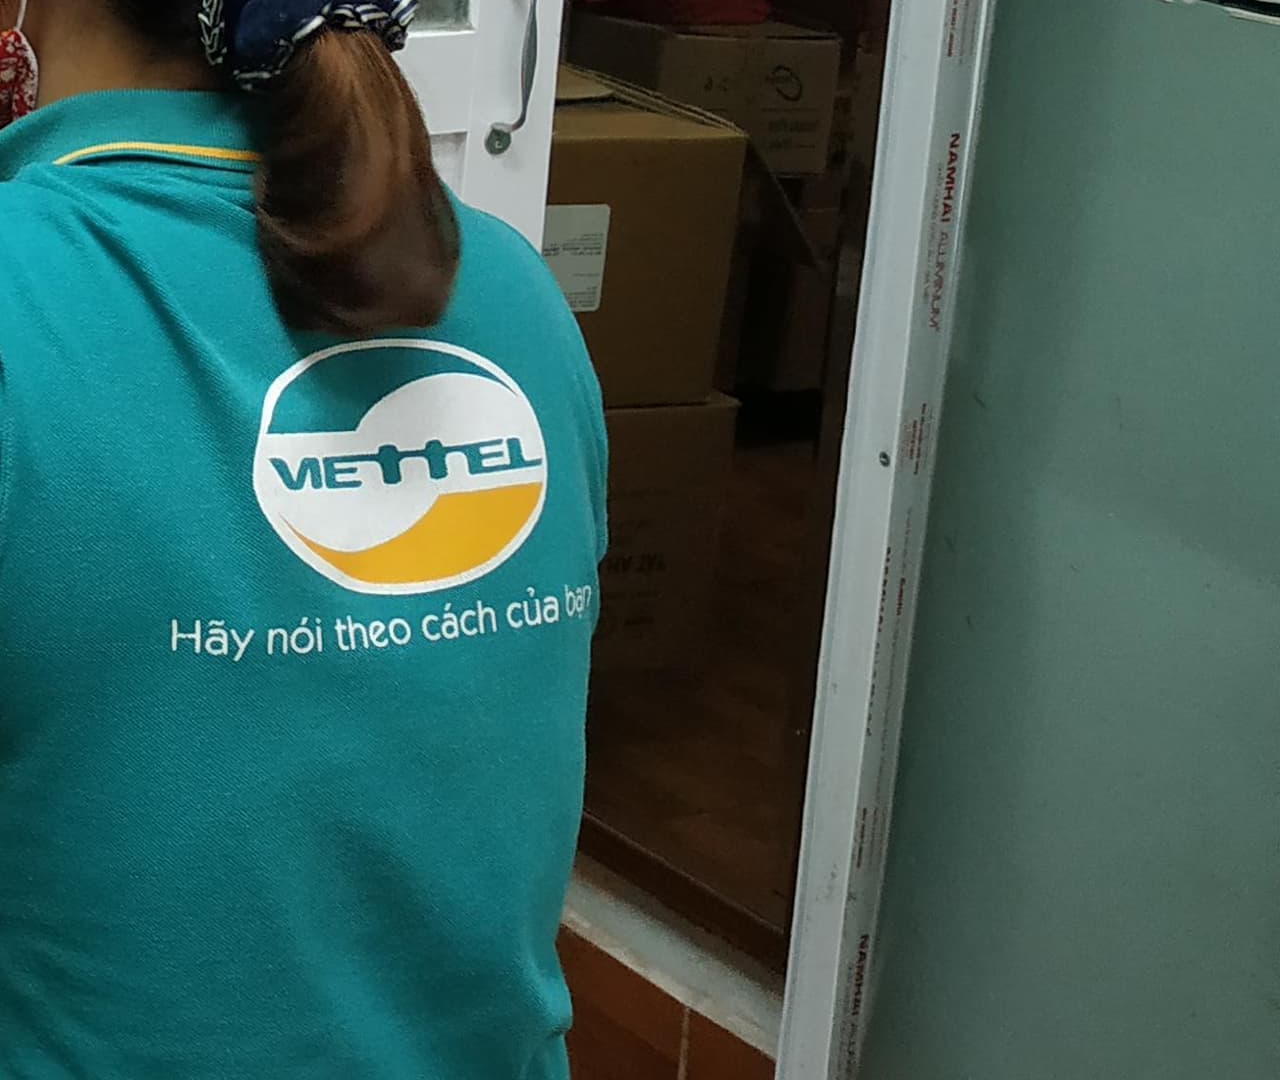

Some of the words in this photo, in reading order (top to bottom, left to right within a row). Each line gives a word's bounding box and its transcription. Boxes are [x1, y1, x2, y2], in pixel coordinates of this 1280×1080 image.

[941, 133, 960, 222] NAMHAI
[269, 436, 544, 492] VIETTEL
[170, 618, 256, 663] Hãy
[266, 616, 324, 656] nói
[334, 615, 413, 652] theo
[422, 598, 498, 643] cách
[506, 586, 561, 629] của
